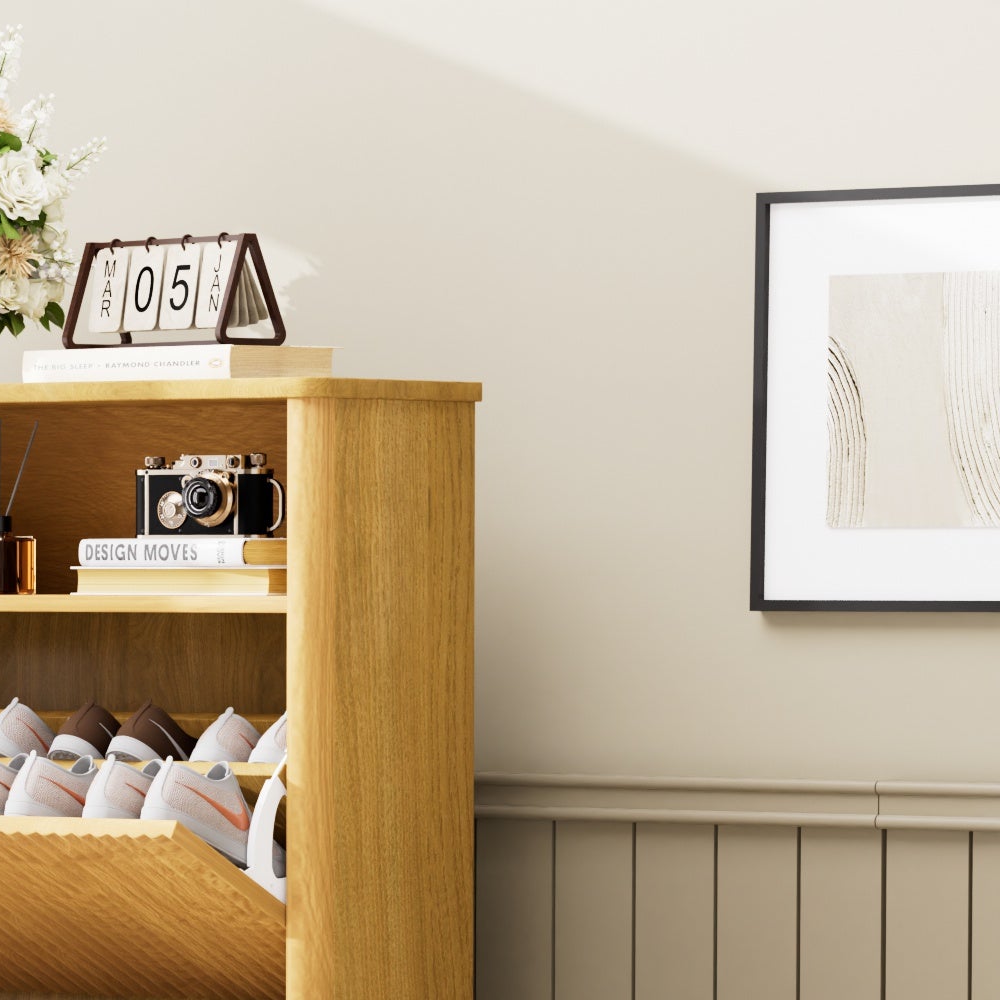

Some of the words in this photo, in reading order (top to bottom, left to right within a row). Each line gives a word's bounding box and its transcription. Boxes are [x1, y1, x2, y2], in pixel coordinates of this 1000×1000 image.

[100, 259, 117, 318] MAR
[208, 254, 222, 312] JAN
[105, 361, 150, 369] RAYMOND
[153, 359, 200, 367] CHANDLER
[85, 543, 138, 561] DESIGN
[144, 543, 198, 561] MOVES
